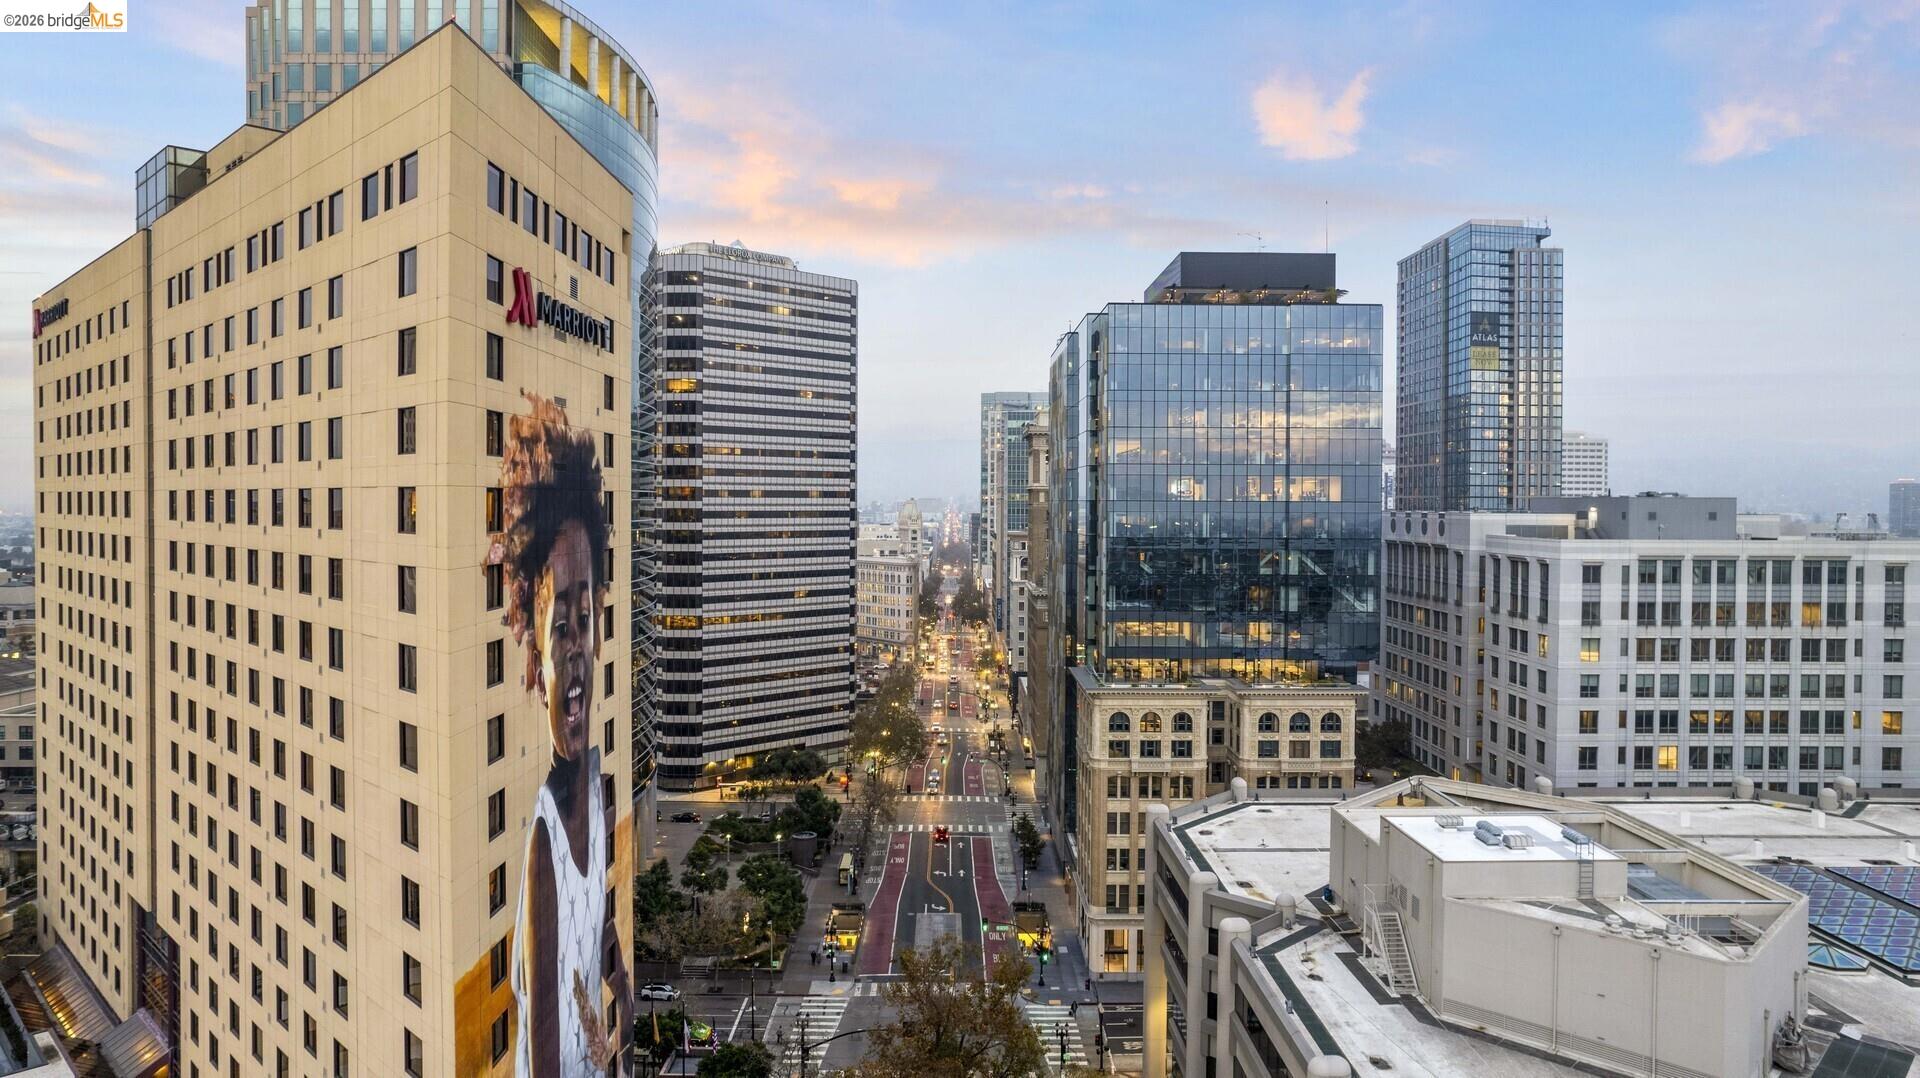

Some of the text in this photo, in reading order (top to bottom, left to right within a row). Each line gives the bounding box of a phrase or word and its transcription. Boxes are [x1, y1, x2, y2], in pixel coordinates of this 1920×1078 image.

[753, 252, 787, 265] COMPANY
[537, 292, 609, 349] MARRIOTT
[1472, 333, 1498, 342] ATLAS
[988, 932, 1006, 940] ONLY
